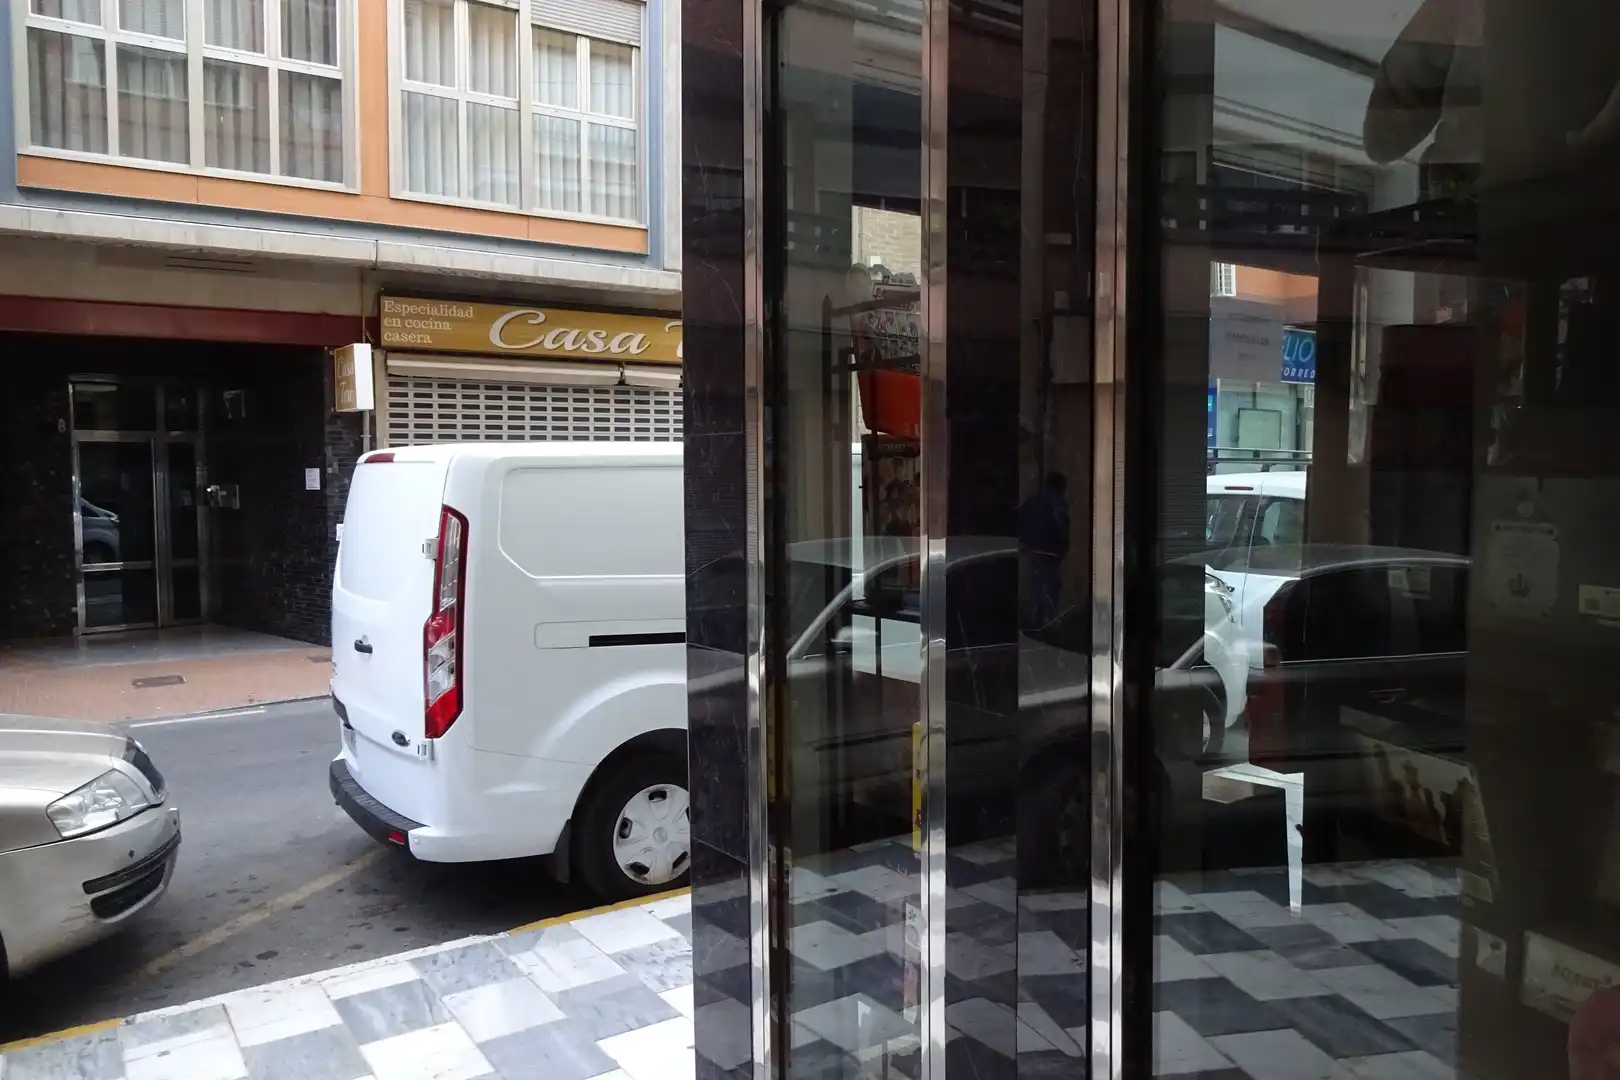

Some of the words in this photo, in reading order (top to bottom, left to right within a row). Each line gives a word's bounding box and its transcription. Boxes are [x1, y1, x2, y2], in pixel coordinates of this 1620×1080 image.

[383, 299, 475, 318] Especialidad
[383, 316, 402, 328] en
[405, 318, 453, 330] cocina
[488, 308, 652, 355] Casa
[383, 331, 433, 343] casera
[1281, 334, 1315, 361] LIO
